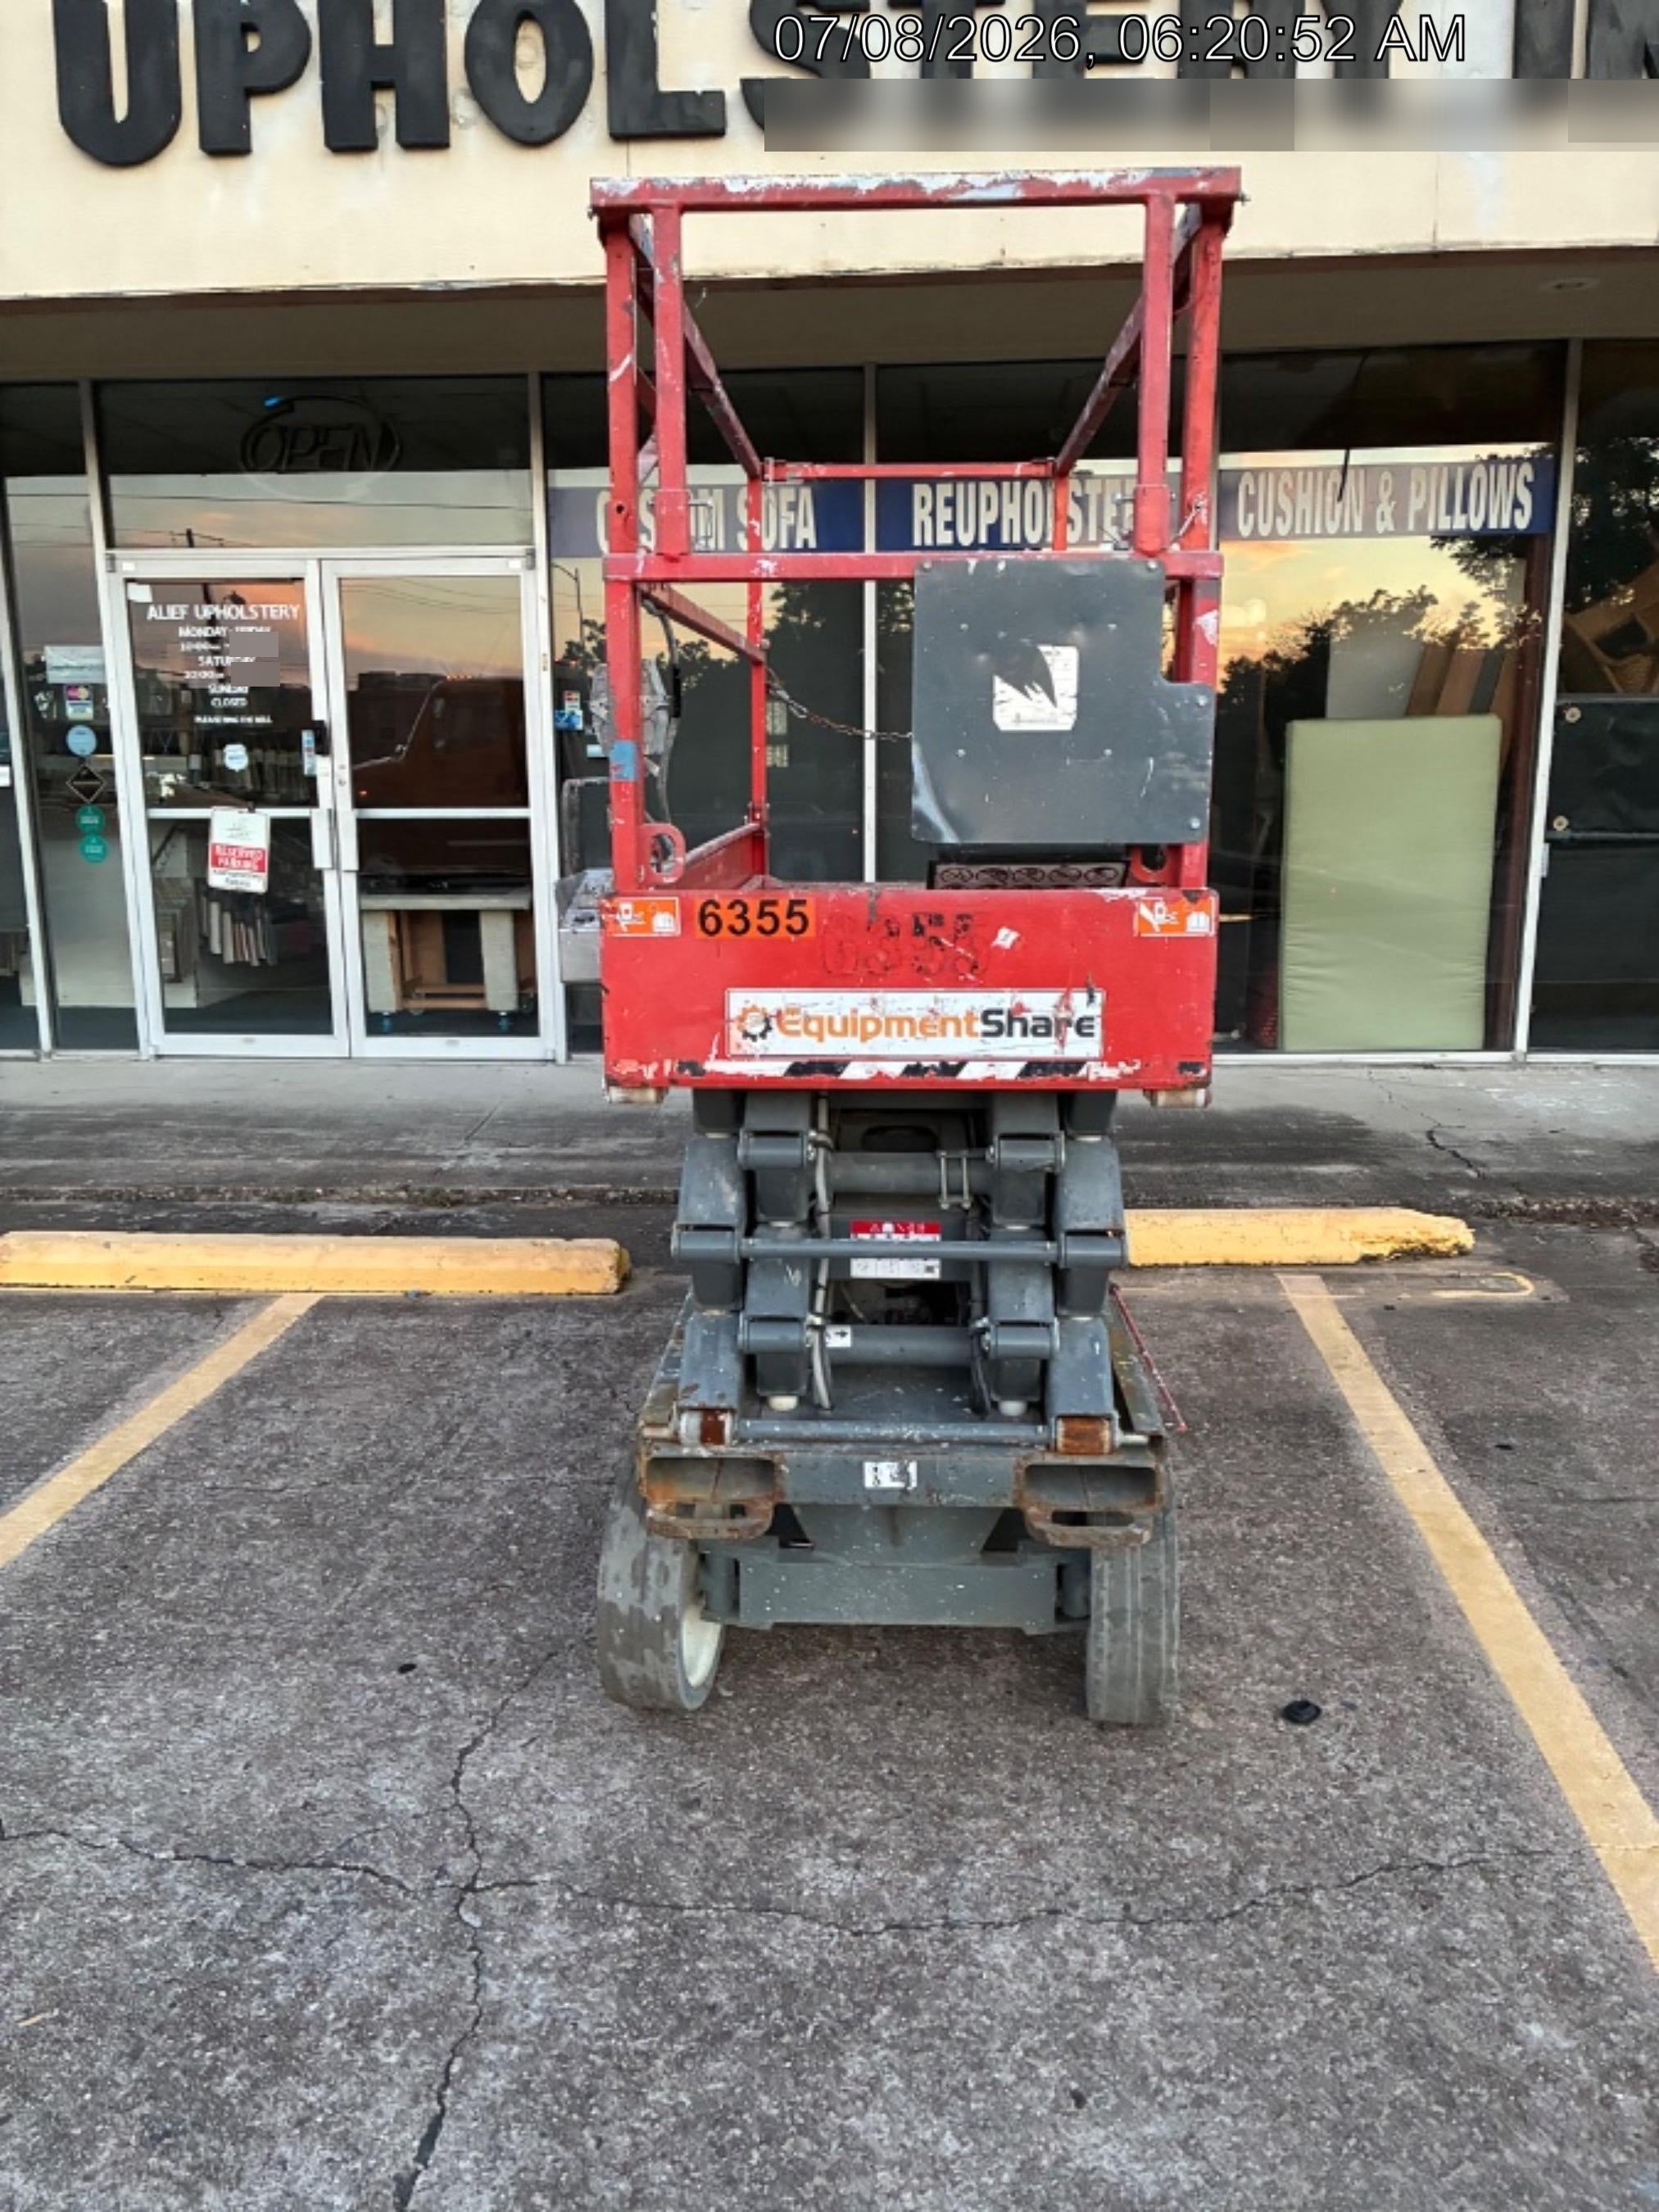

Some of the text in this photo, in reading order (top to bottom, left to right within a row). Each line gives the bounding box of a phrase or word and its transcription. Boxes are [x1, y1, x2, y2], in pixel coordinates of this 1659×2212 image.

[1237, 462, 1535, 537] CUSHION & PILLOWS
[193, 604, 301, 620] UPHOLSTERY
[178, 626, 228, 637] MONDAY
[698, 899, 809, 937] 6355
[777, 1007, 1096, 1043] EquipmentShare
